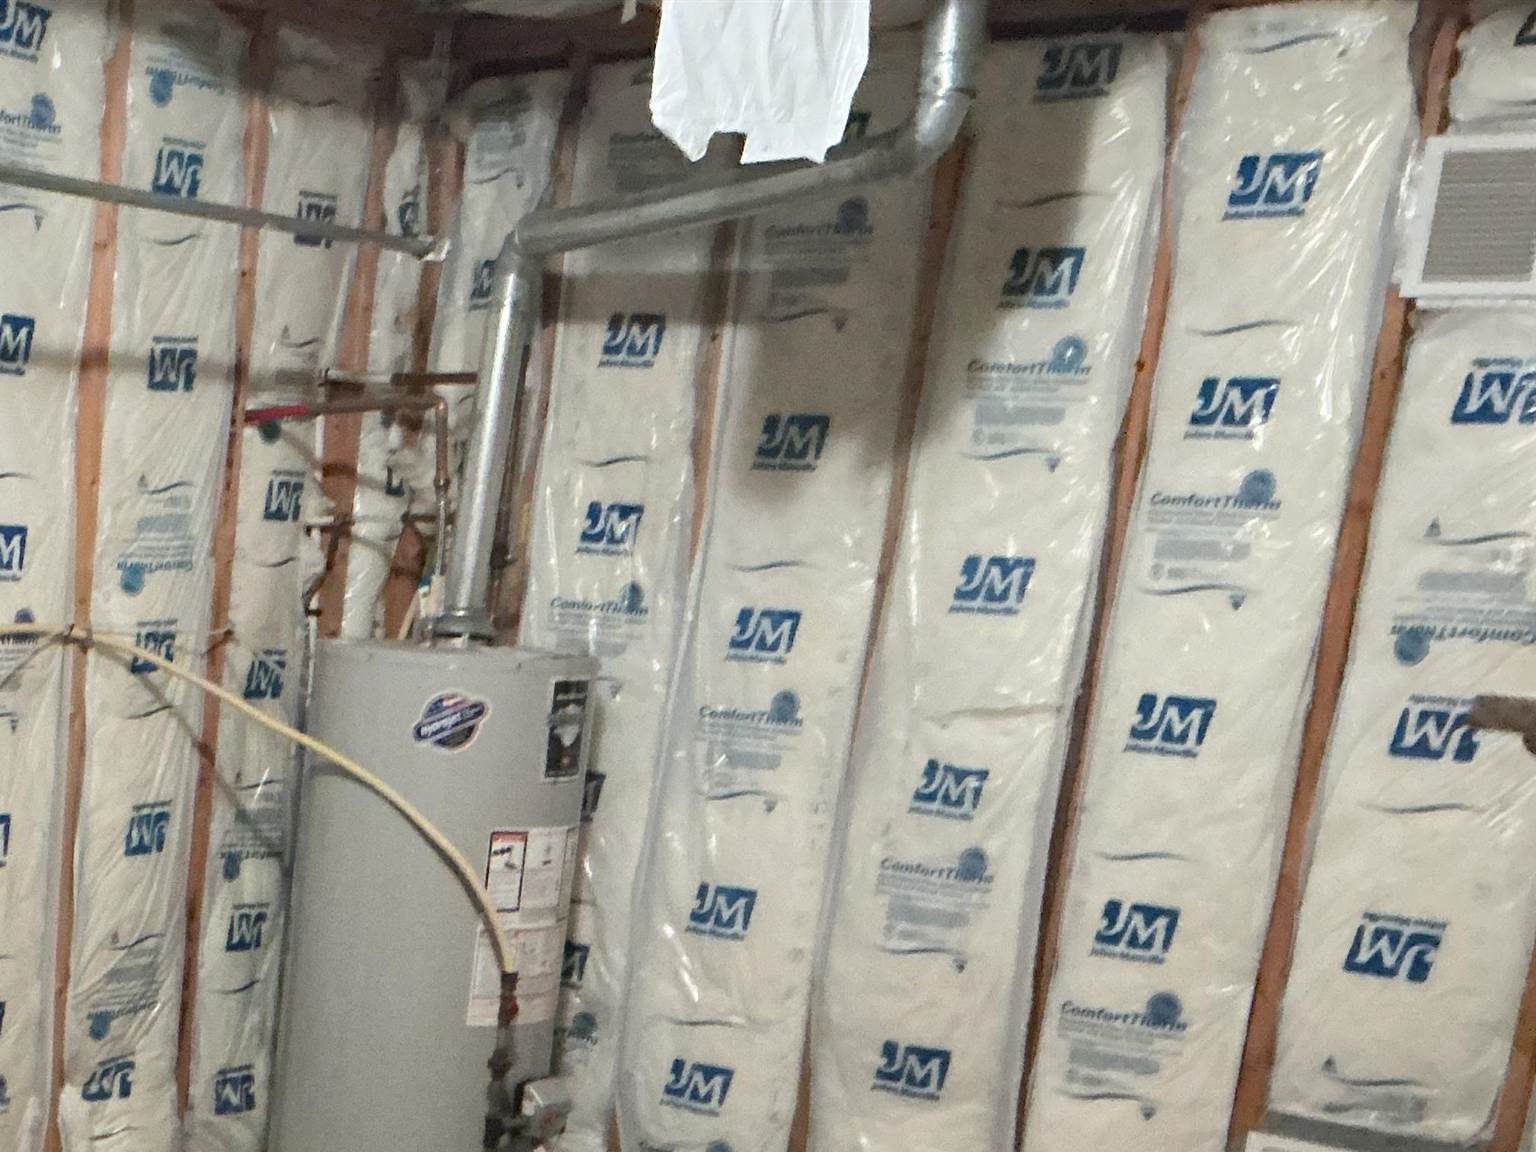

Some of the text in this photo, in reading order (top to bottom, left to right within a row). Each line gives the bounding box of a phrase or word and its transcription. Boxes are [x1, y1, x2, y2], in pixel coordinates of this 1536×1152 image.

[1036, 42, 1123, 91] JM
[152, 147, 204, 198] JM
[1228, 150, 1324, 206] JM
[1002, 247, 1086, 296] JM
[602, 312, 666, 357] JM
[147, 346, 198, 391] JM
[1188, 376, 1280, 426] JM
[755, 412, 830, 460] JM
[579, 501, 644, 544] JM
[1149, 491, 1282, 511] ComfortTherm
[954, 554, 1036, 604] JM
[728, 606, 802, 653] JM
[698, 704, 804, 728] ComfortTherm
[1129, 693, 1217, 746] JM
[913, 758, 989, 808] JM
[124, 811, 170, 856] JM
[689, 881, 758, 931] JM
[1094, 899, 1181, 953] JM
[1343, 924, 1442, 983] JM
[1061, 1000, 1188, 1032] ComfortTherm
[663, 1057, 735, 1106] JM
[875, 1039, 951, 1091] JM
